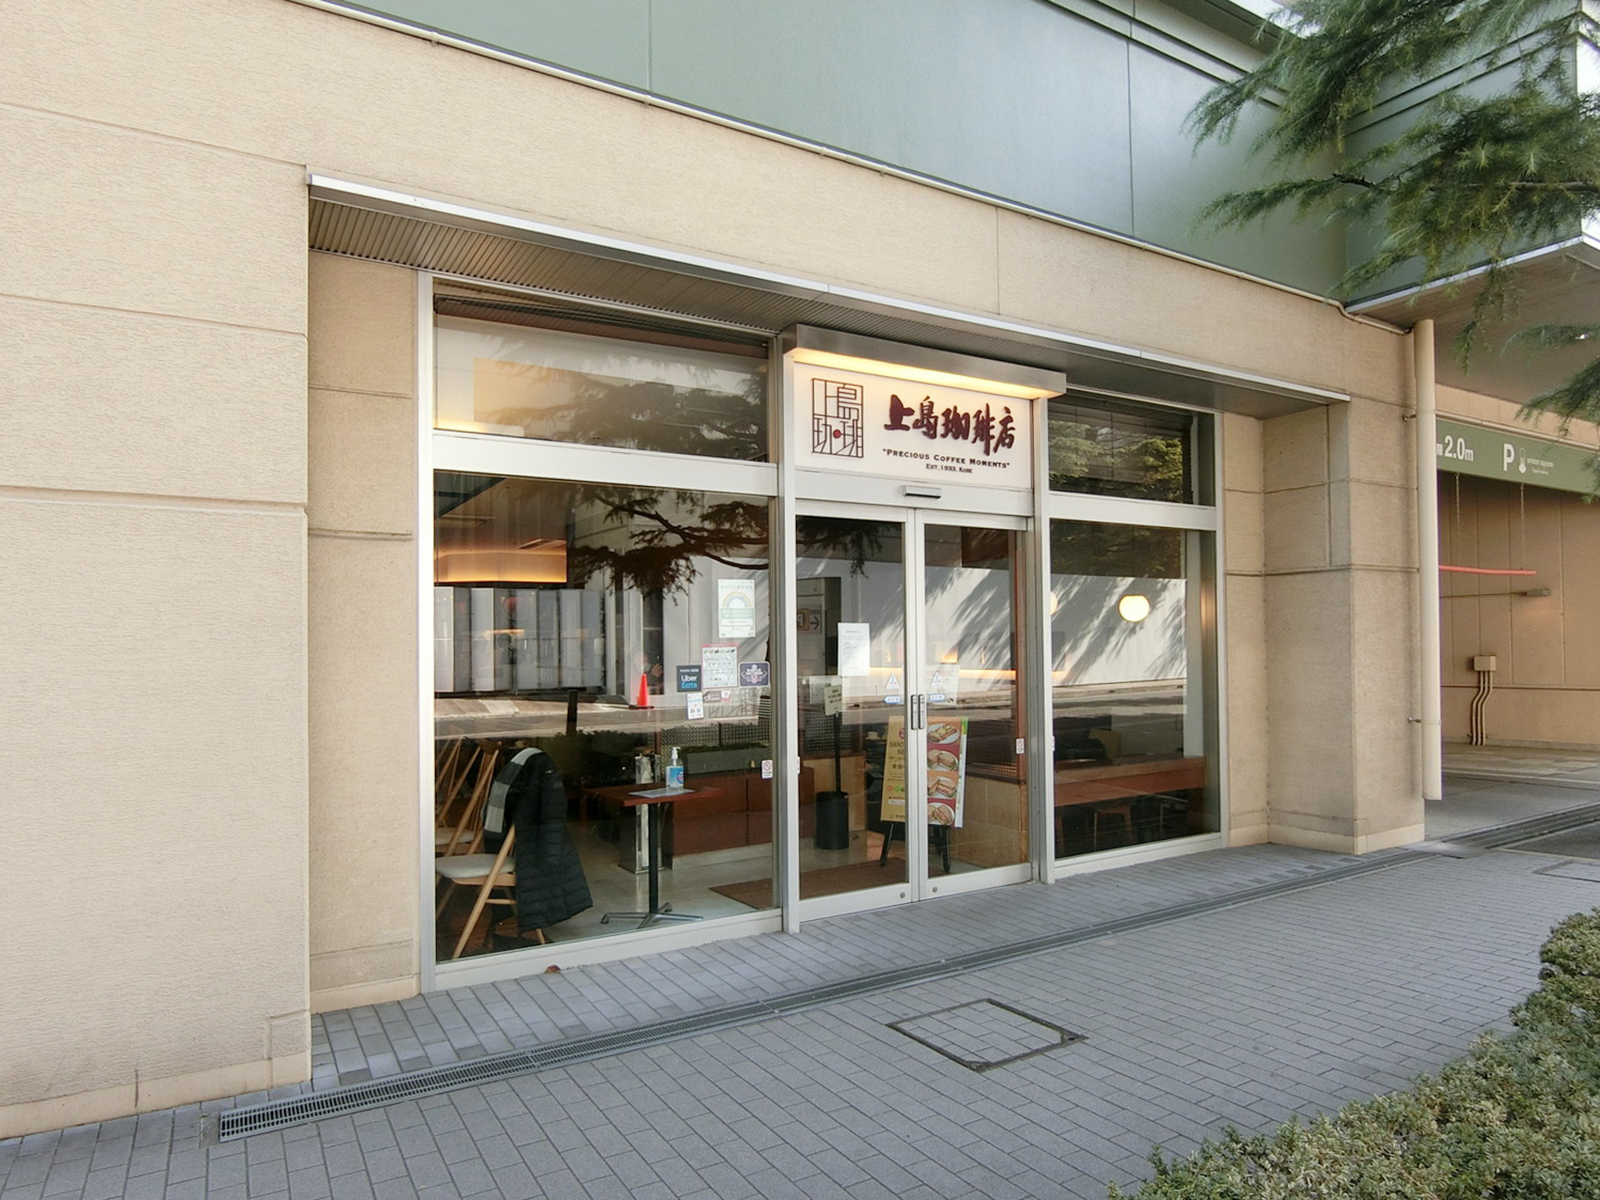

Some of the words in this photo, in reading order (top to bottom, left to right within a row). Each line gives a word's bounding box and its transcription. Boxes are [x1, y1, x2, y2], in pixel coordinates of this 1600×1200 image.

[884, 394, 1016, 456] 上島珈琲店
[1444, 434, 1474, 462] 2.0m
[1503, 443, 1515, 471] P
[681, 674, 698, 682] Uber
